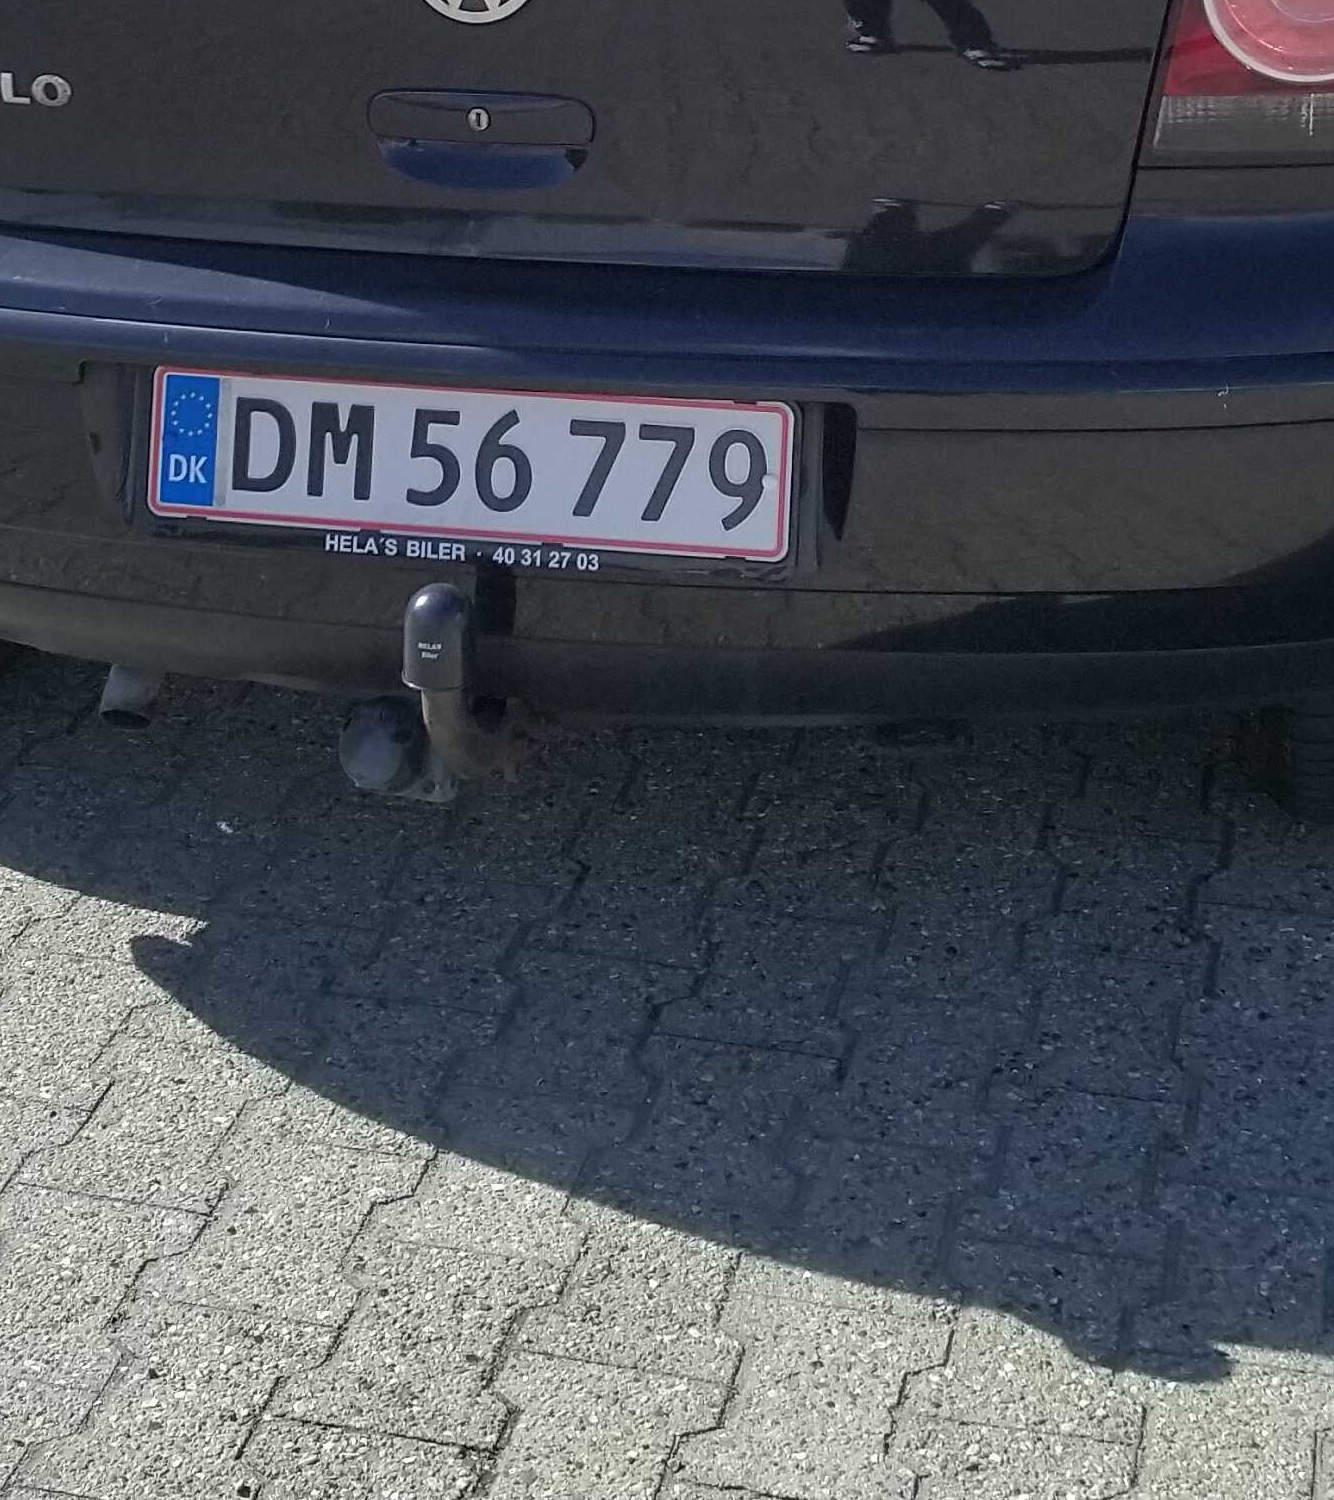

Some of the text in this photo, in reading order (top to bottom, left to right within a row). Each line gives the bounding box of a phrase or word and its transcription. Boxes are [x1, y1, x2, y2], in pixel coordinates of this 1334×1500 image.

[168, 454, 207, 485] DK
[232, 396, 766, 531] DM 56 779
[406, 539, 466, 562] BILER
[492, 546, 515, 565] 40
[520, 549, 542, 567] 31
[548, 551, 571, 569] 27
[577, 553, 600, 571] 03
